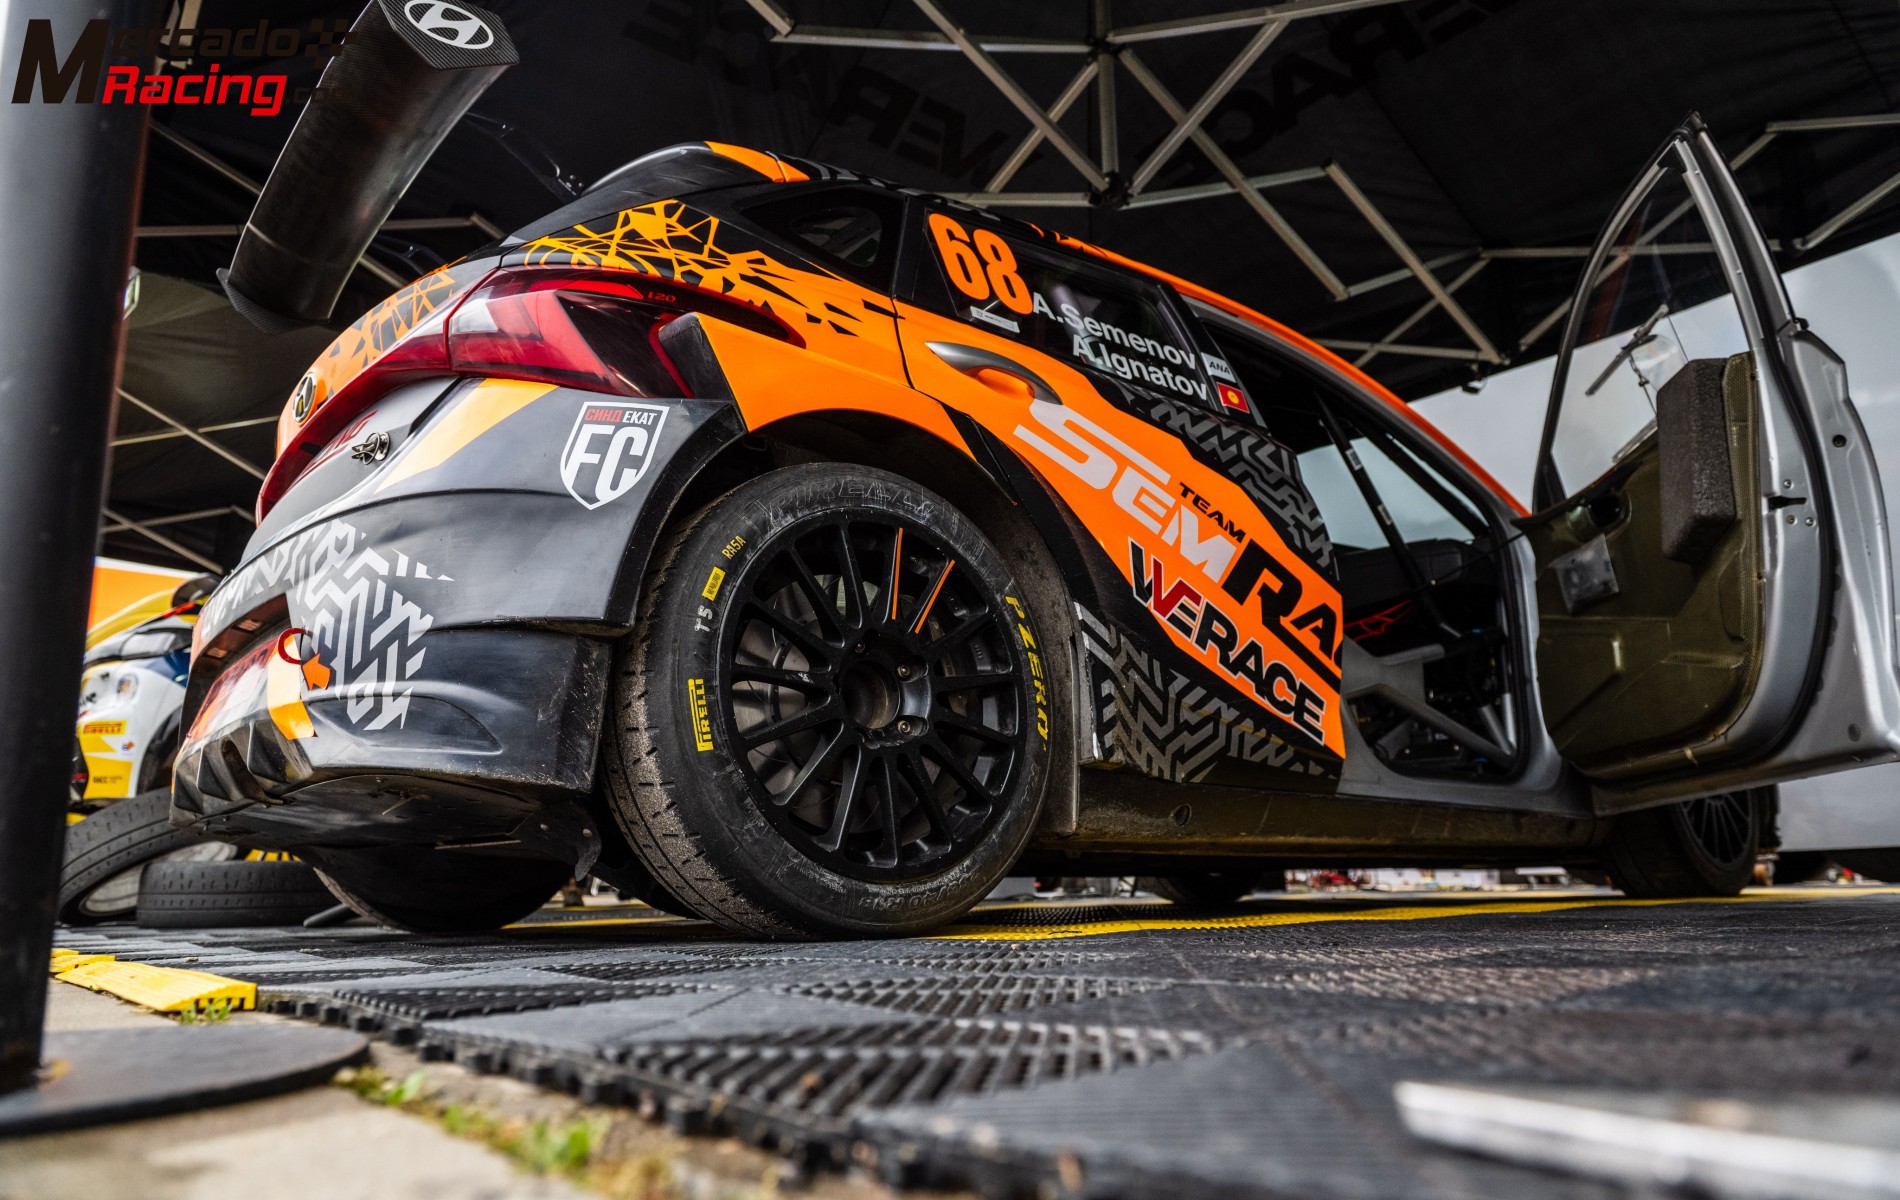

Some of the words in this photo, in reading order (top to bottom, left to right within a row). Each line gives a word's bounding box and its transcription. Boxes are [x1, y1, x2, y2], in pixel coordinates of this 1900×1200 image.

[928, 213, 1034, 315] 68
[1033, 292, 1196, 370] A.Semenov
[1209, 361, 1231, 375] ANA
[564, 424, 649, 502] FC
[721, 535, 747, 560] RA5A
[1179, 481, 1247, 544] TEAM
[1127, 535, 1326, 746] WERACE
[688, 678, 714, 752] PIRELLI
